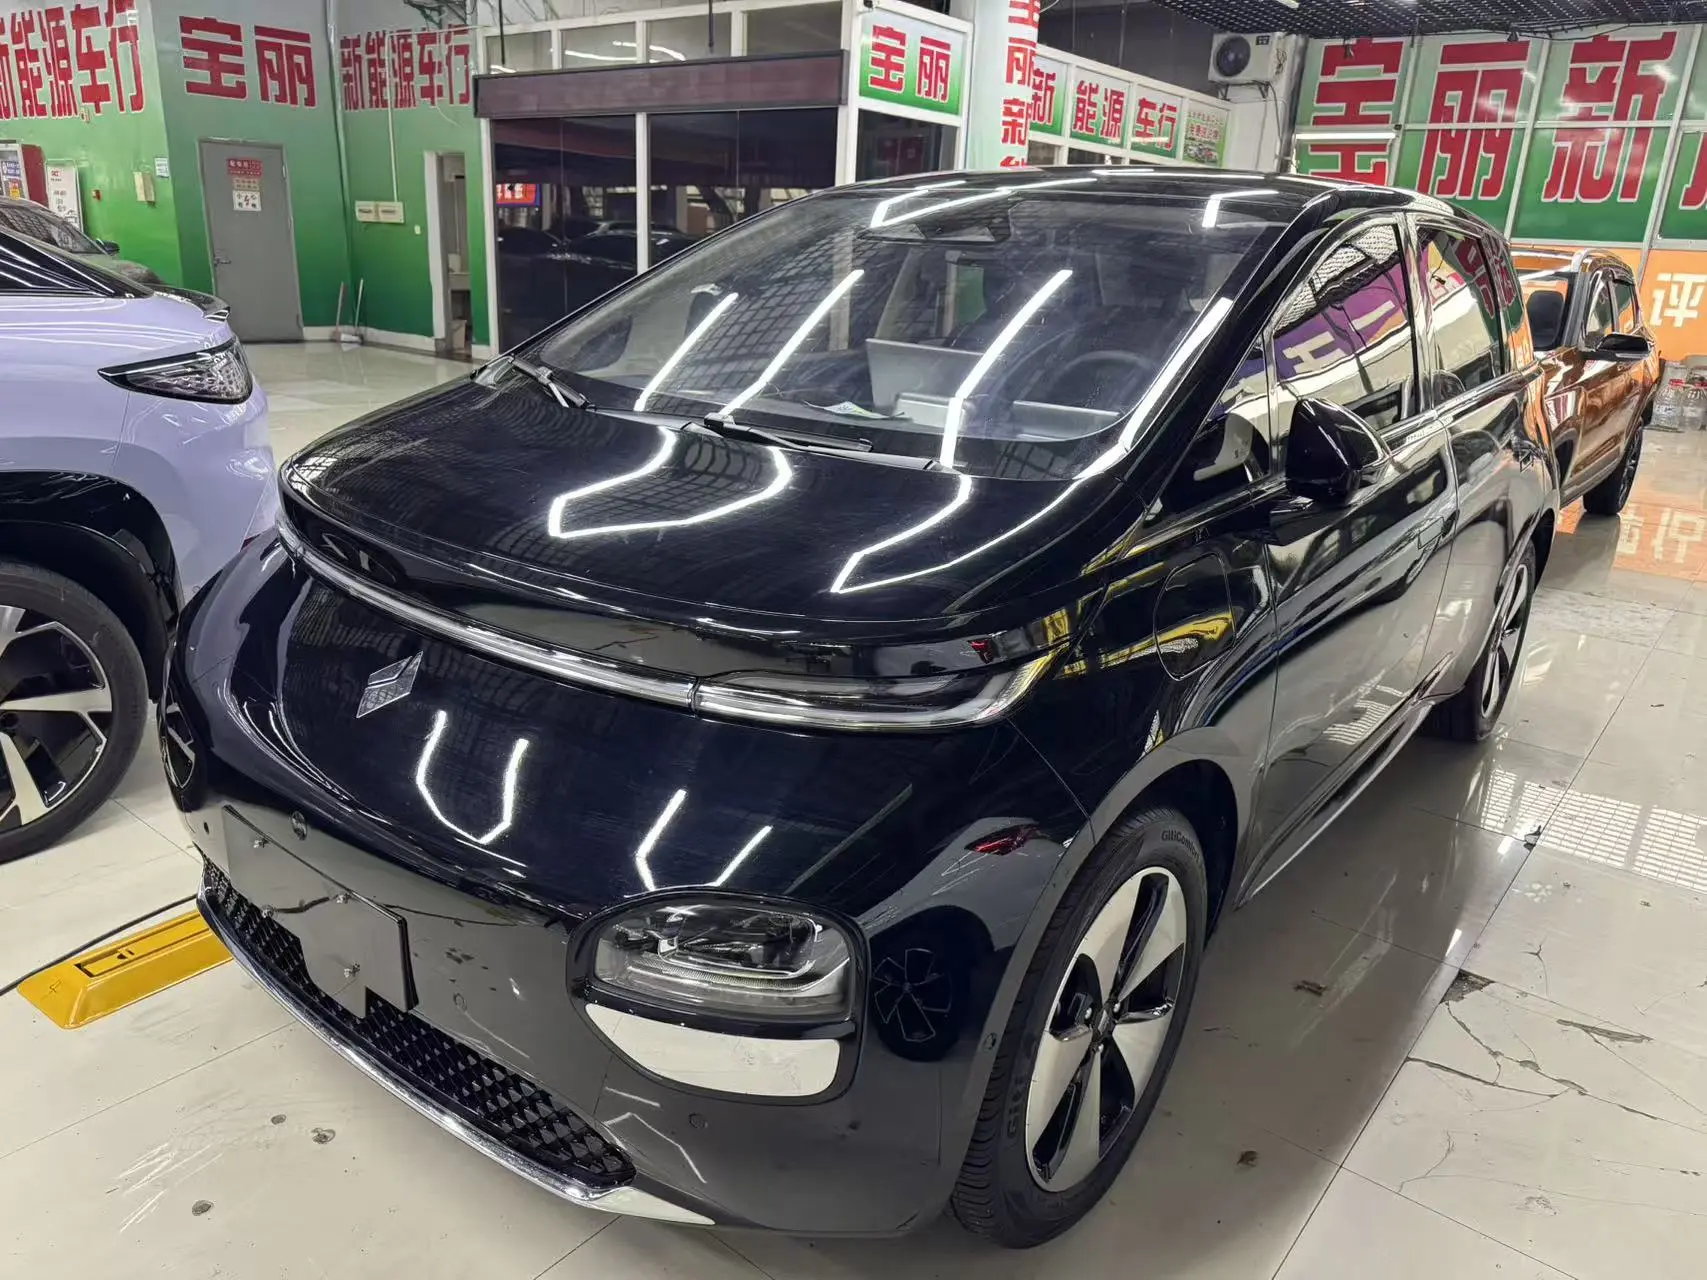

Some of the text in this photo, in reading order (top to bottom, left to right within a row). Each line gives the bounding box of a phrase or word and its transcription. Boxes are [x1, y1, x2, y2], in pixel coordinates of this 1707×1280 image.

[179, 15, 317, 109] 宝丽
[340, 23, 470, 112] 新能源车行
[868, 24, 952, 103] 宝丽
[1031, 67, 1178, 151] 新能源车行
[1650, 273, 1707, 328] 评
